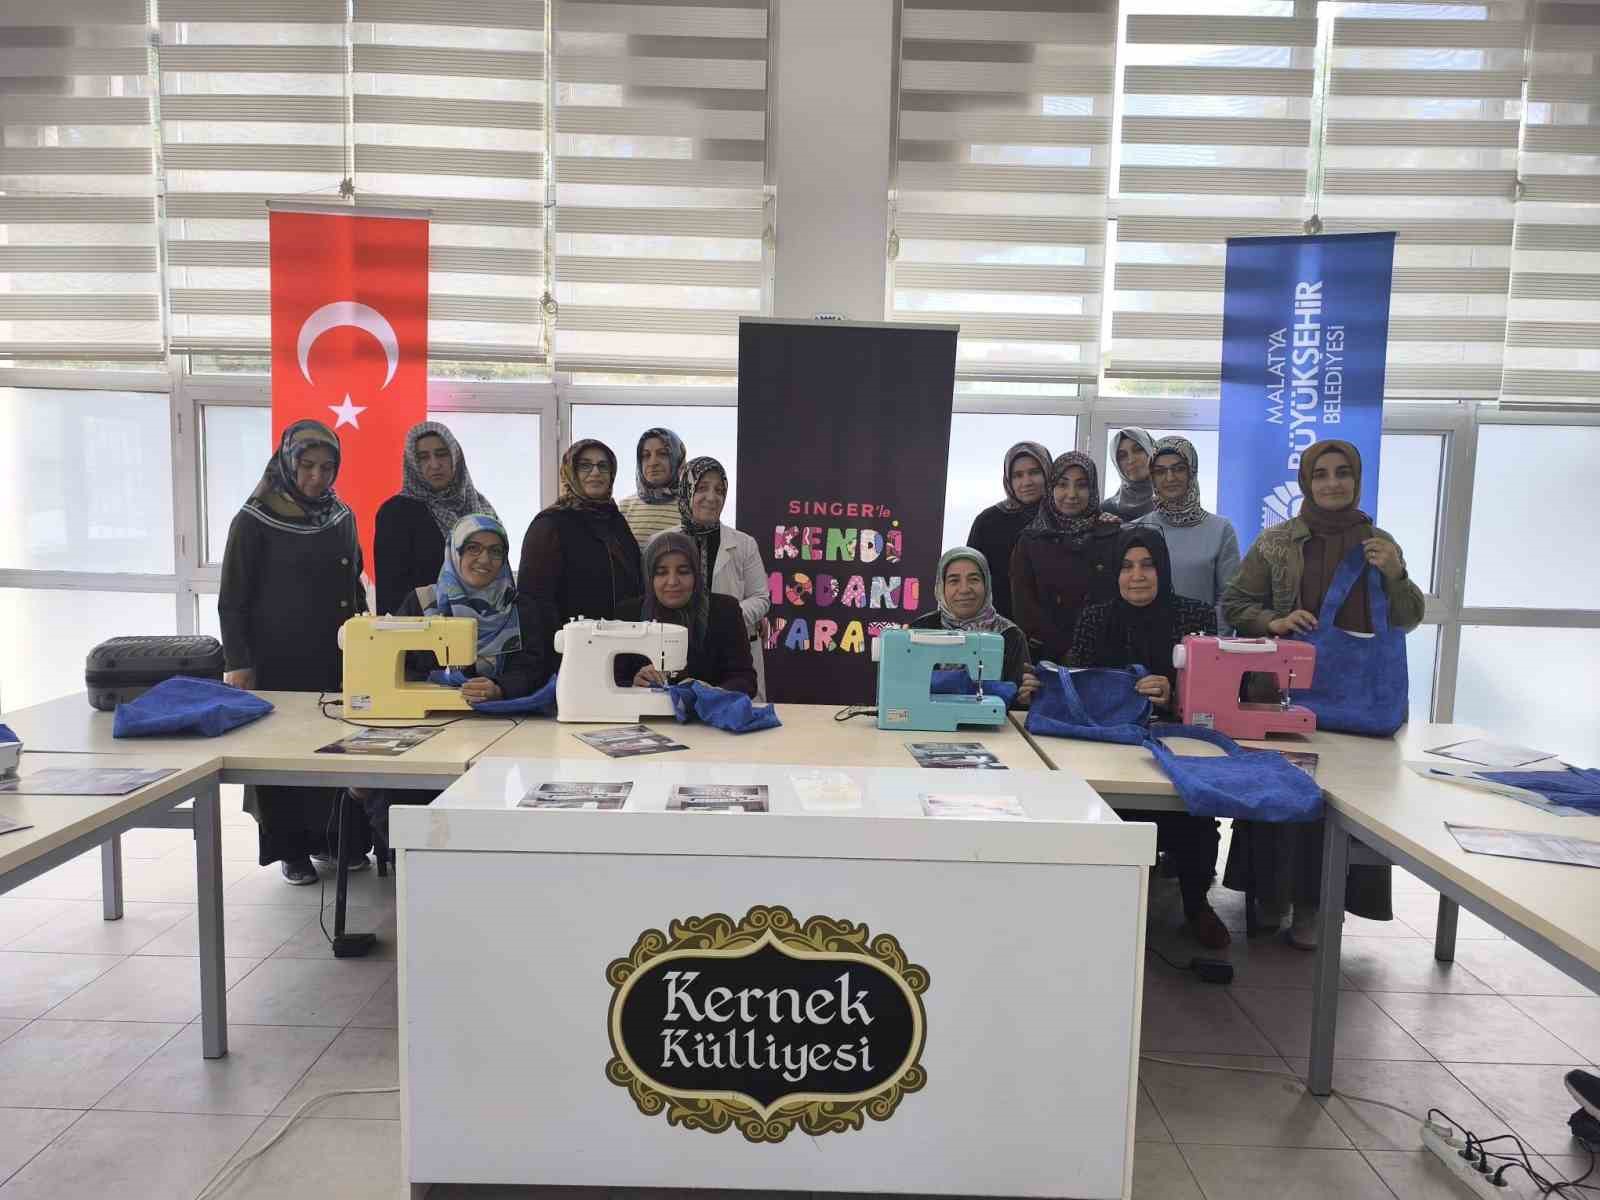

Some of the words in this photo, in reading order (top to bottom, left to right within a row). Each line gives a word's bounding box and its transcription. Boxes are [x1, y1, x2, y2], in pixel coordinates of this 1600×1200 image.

[1266, 327, 1287, 424] MALATYA
[1323, 325, 1345, 424] BELEDİYESİ
[774, 520, 903, 563] KENDİ
[661, 971, 875, 1026] Kernek
[660, 1028, 875, 1082] Külliyesi
